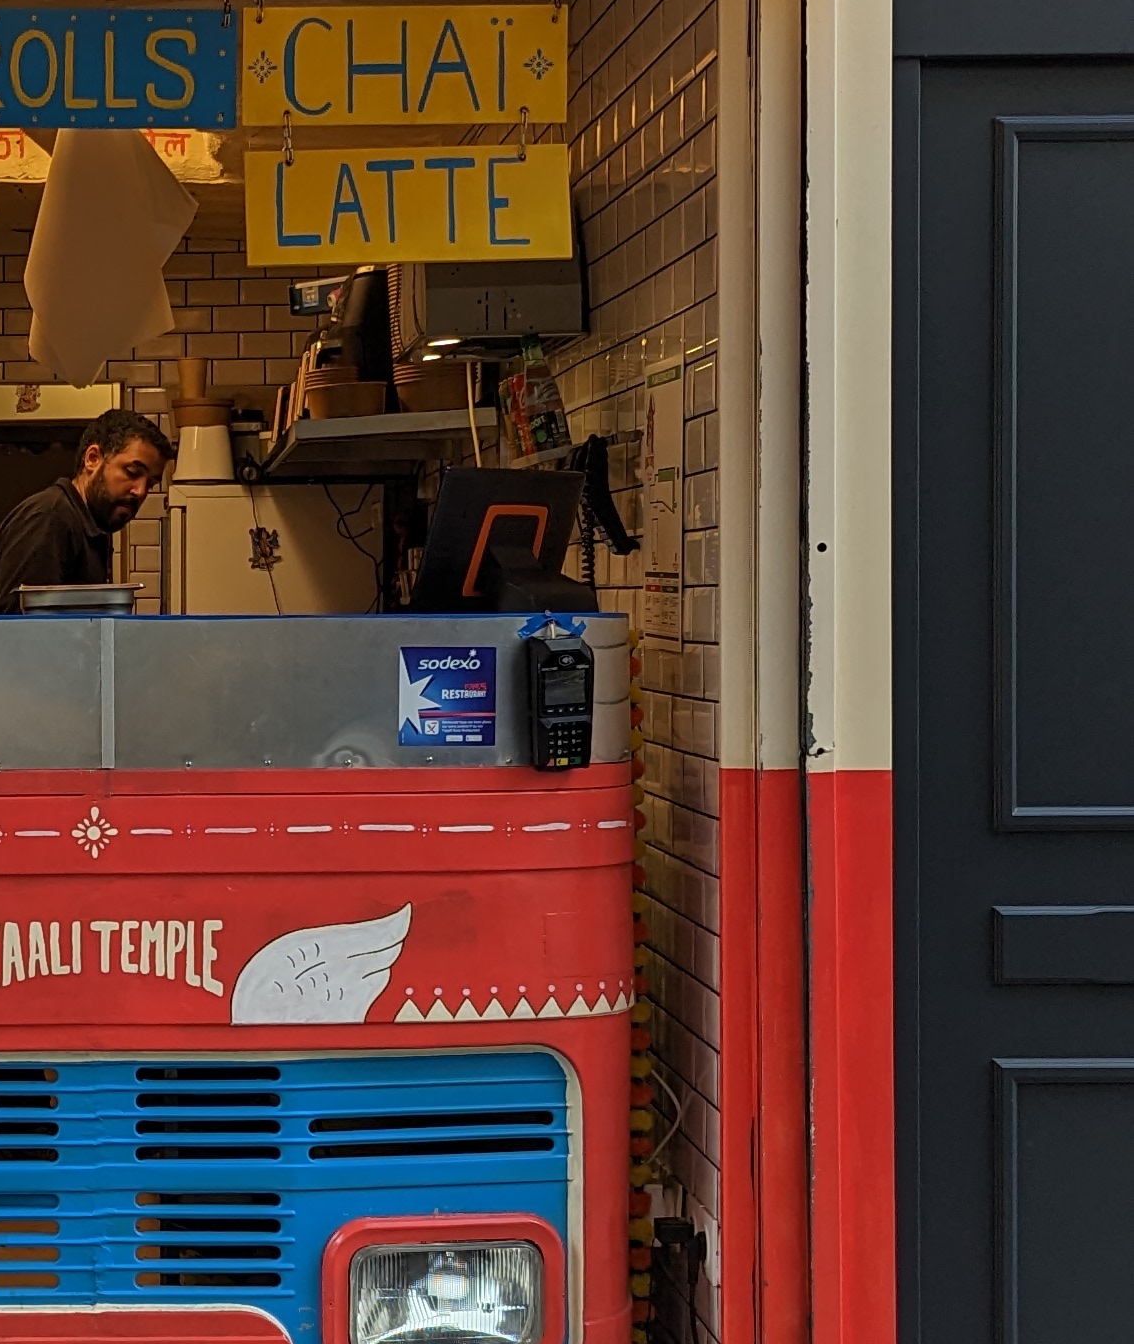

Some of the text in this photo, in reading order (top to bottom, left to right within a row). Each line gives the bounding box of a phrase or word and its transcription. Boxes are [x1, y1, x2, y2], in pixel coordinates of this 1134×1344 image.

[282, 17, 514, 116] CHAÏ
[275, 156, 531, 247] LATTE
[418, 654, 481, 670] sodexo
[89, 920, 224, 998] TEMPLE
